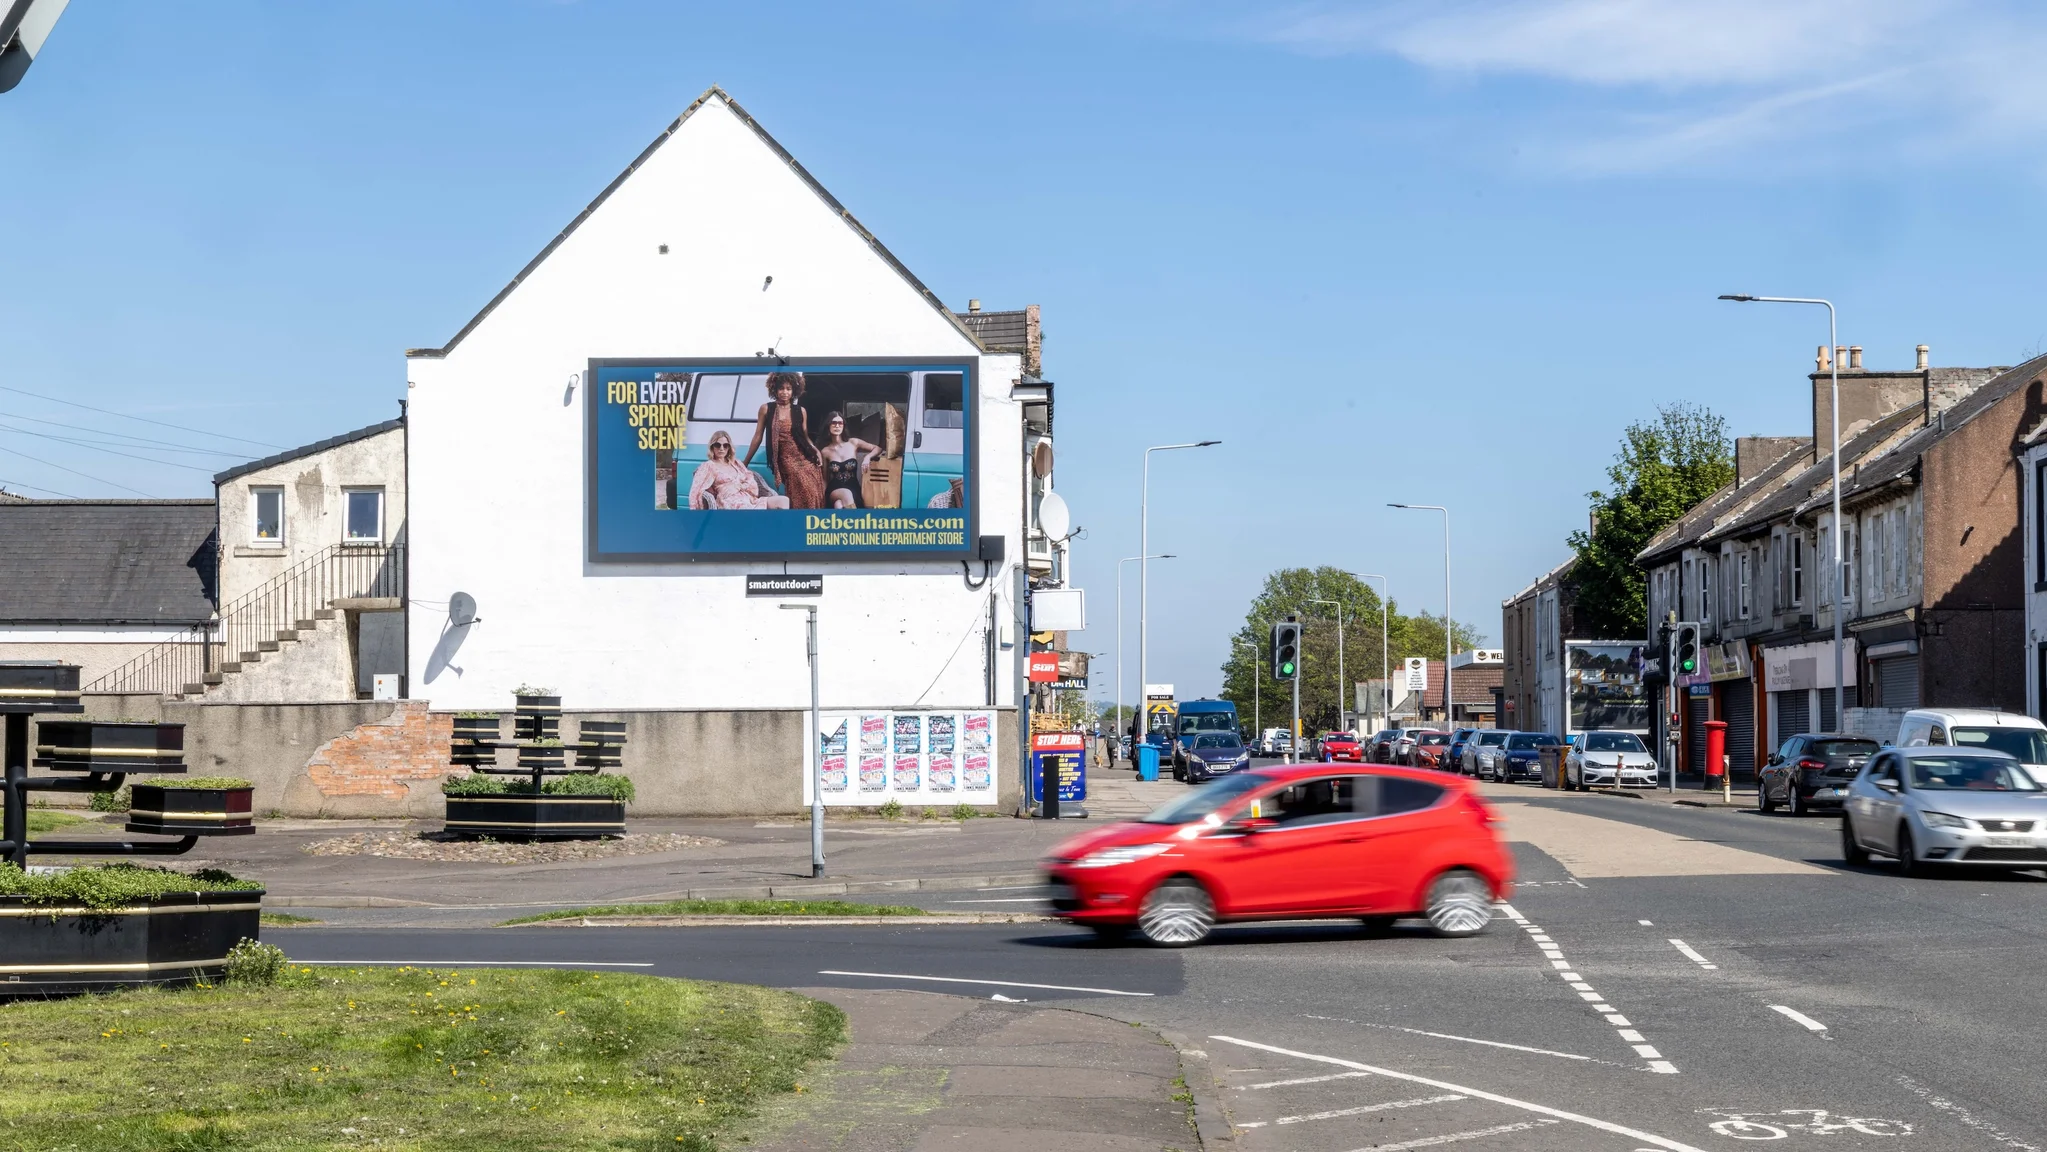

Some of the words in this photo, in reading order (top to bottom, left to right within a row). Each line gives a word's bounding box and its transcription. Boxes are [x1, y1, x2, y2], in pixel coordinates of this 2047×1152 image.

[608, 381, 637, 404] FOR
[640, 381, 687, 404] EVERY
[629, 404, 686, 427] SPRING
[638, 427, 687, 450] SCENE
[806, 513, 964, 530] Debenhams.com
[806, 532, 848, 546] BRITAIN'S
[849, 532, 880, 545] ONLINE
[881, 532, 936, 545] DEPARTMENT
[937, 531, 964, 545] STORE
[748, 579, 811, 589] smartoutdoor
[1032, 663, 1055, 672] Sun
[1065, 679, 1086, 688] HALL
[1037, 734, 1060, 746] STOP
[1060, 733, 1082, 745] HERE
